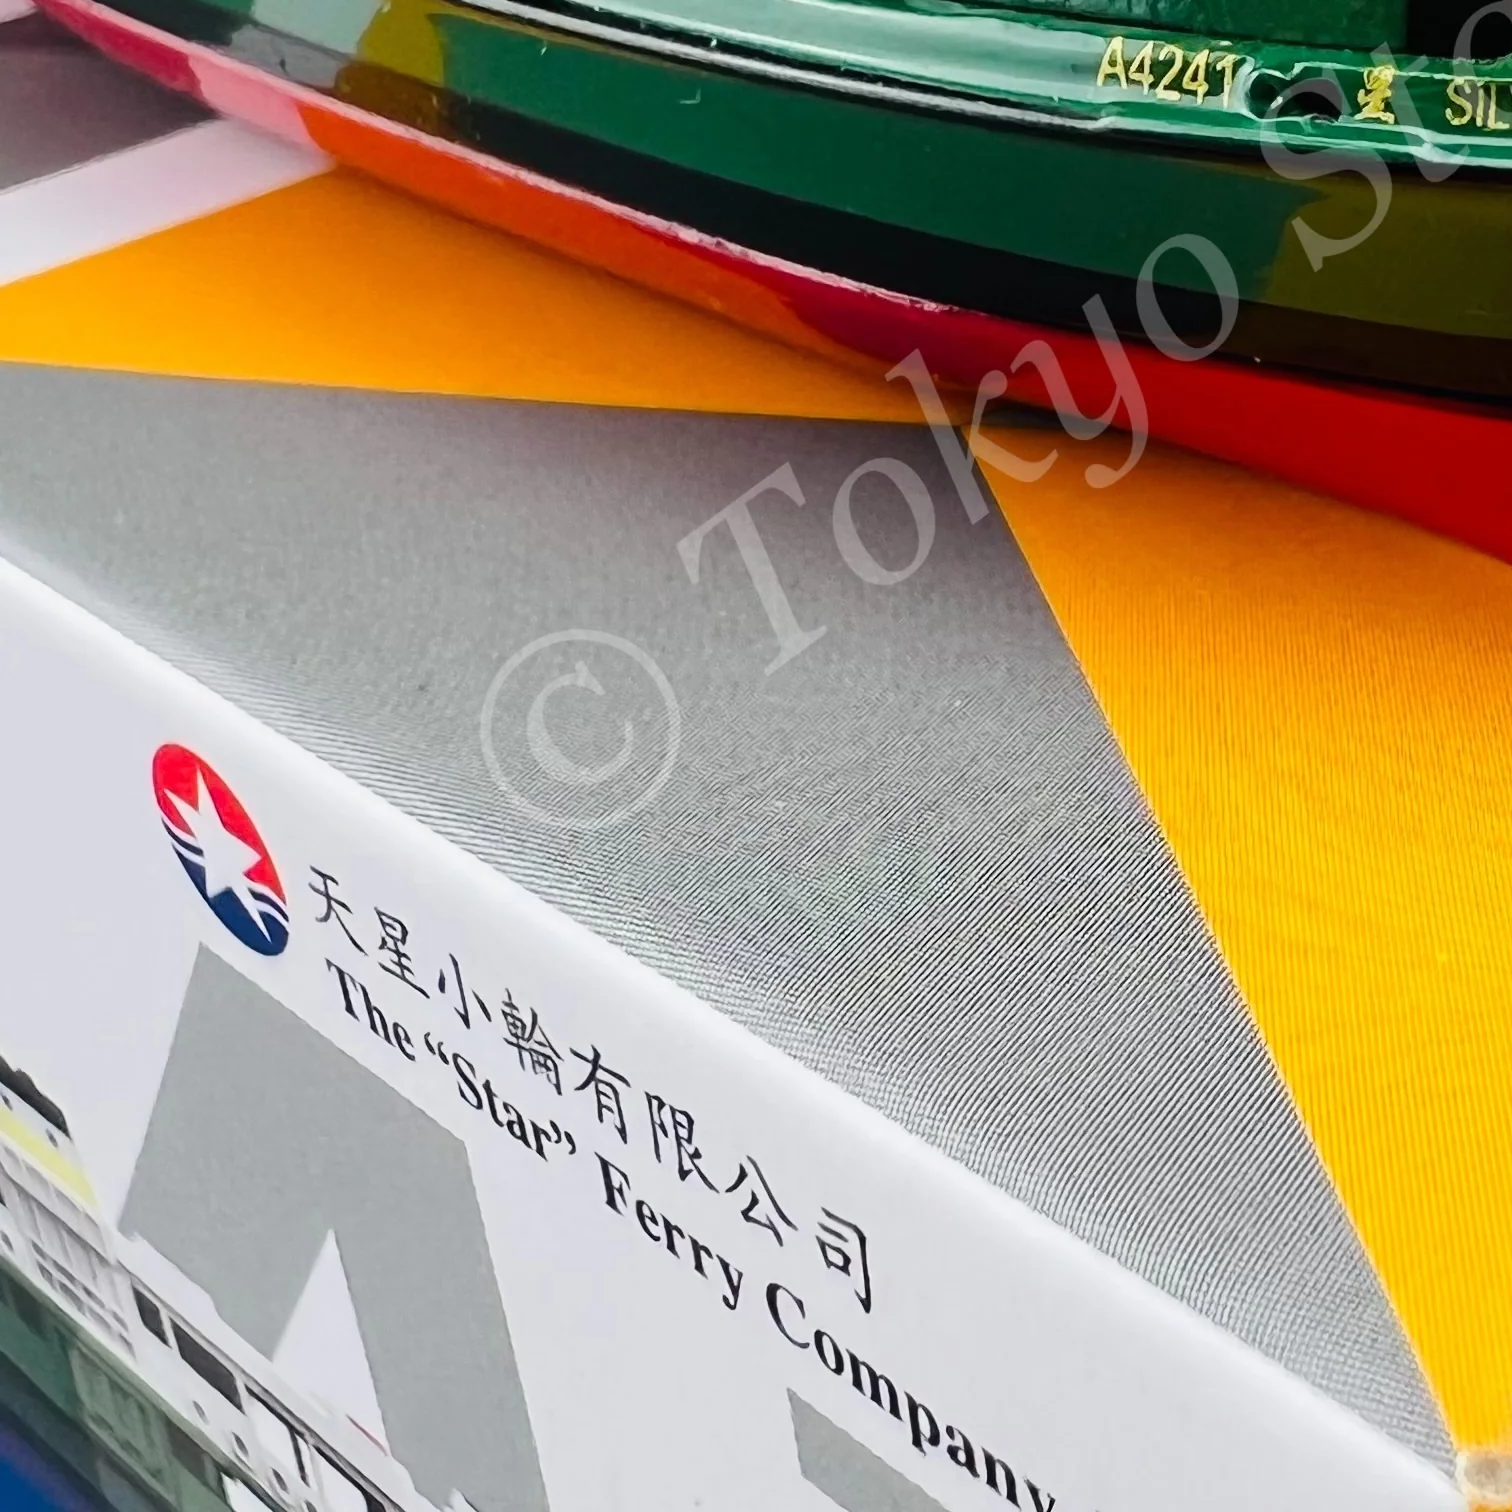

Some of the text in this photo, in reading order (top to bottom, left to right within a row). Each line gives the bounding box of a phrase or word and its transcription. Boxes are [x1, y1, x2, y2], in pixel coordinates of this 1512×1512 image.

[1096, 36, 1238, 109] A4241
[308, 865, 872, 1314] 天星小輪有限公司
[325, 957, 416, 1062] The
[594, 1151, 744, 1311] Ferry
